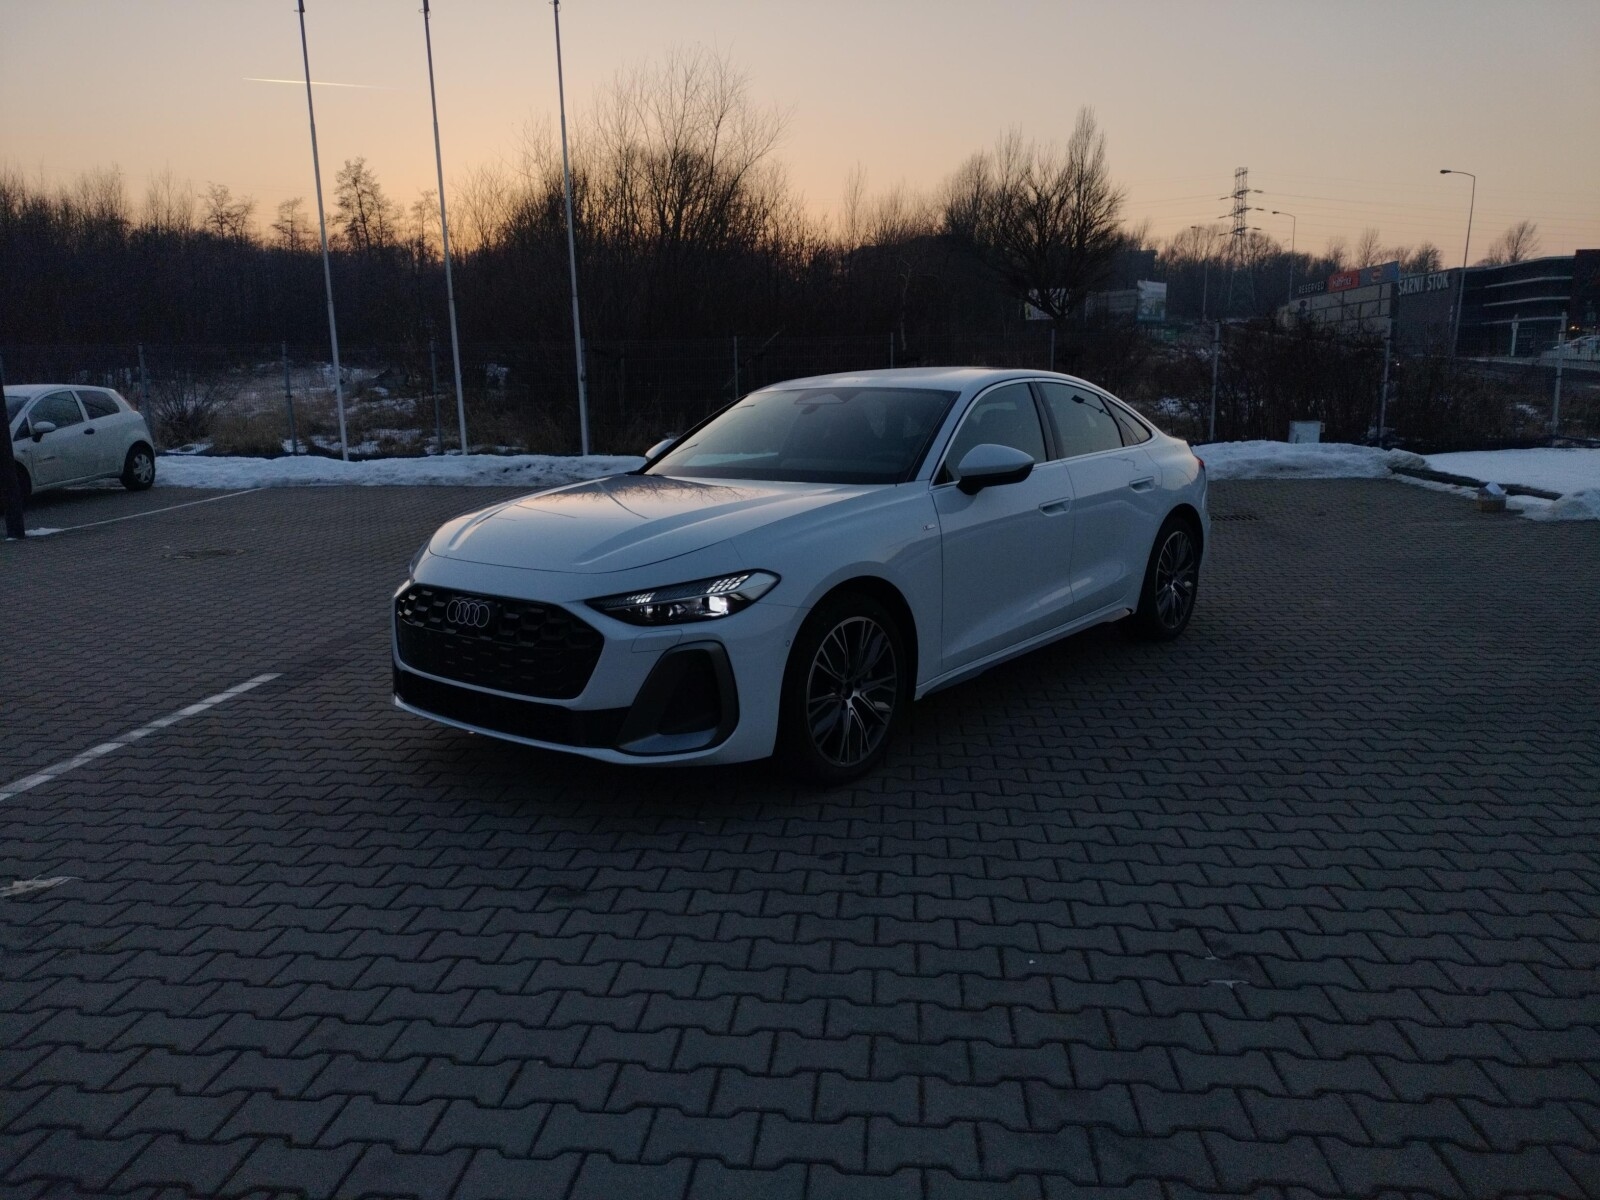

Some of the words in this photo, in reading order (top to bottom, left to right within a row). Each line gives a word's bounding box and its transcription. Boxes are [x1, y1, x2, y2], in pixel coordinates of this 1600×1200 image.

[1298, 281, 1325, 294] RESERVED
[1398, 275, 1424, 296] SARNI
[1427, 271, 1449, 291] STOK
